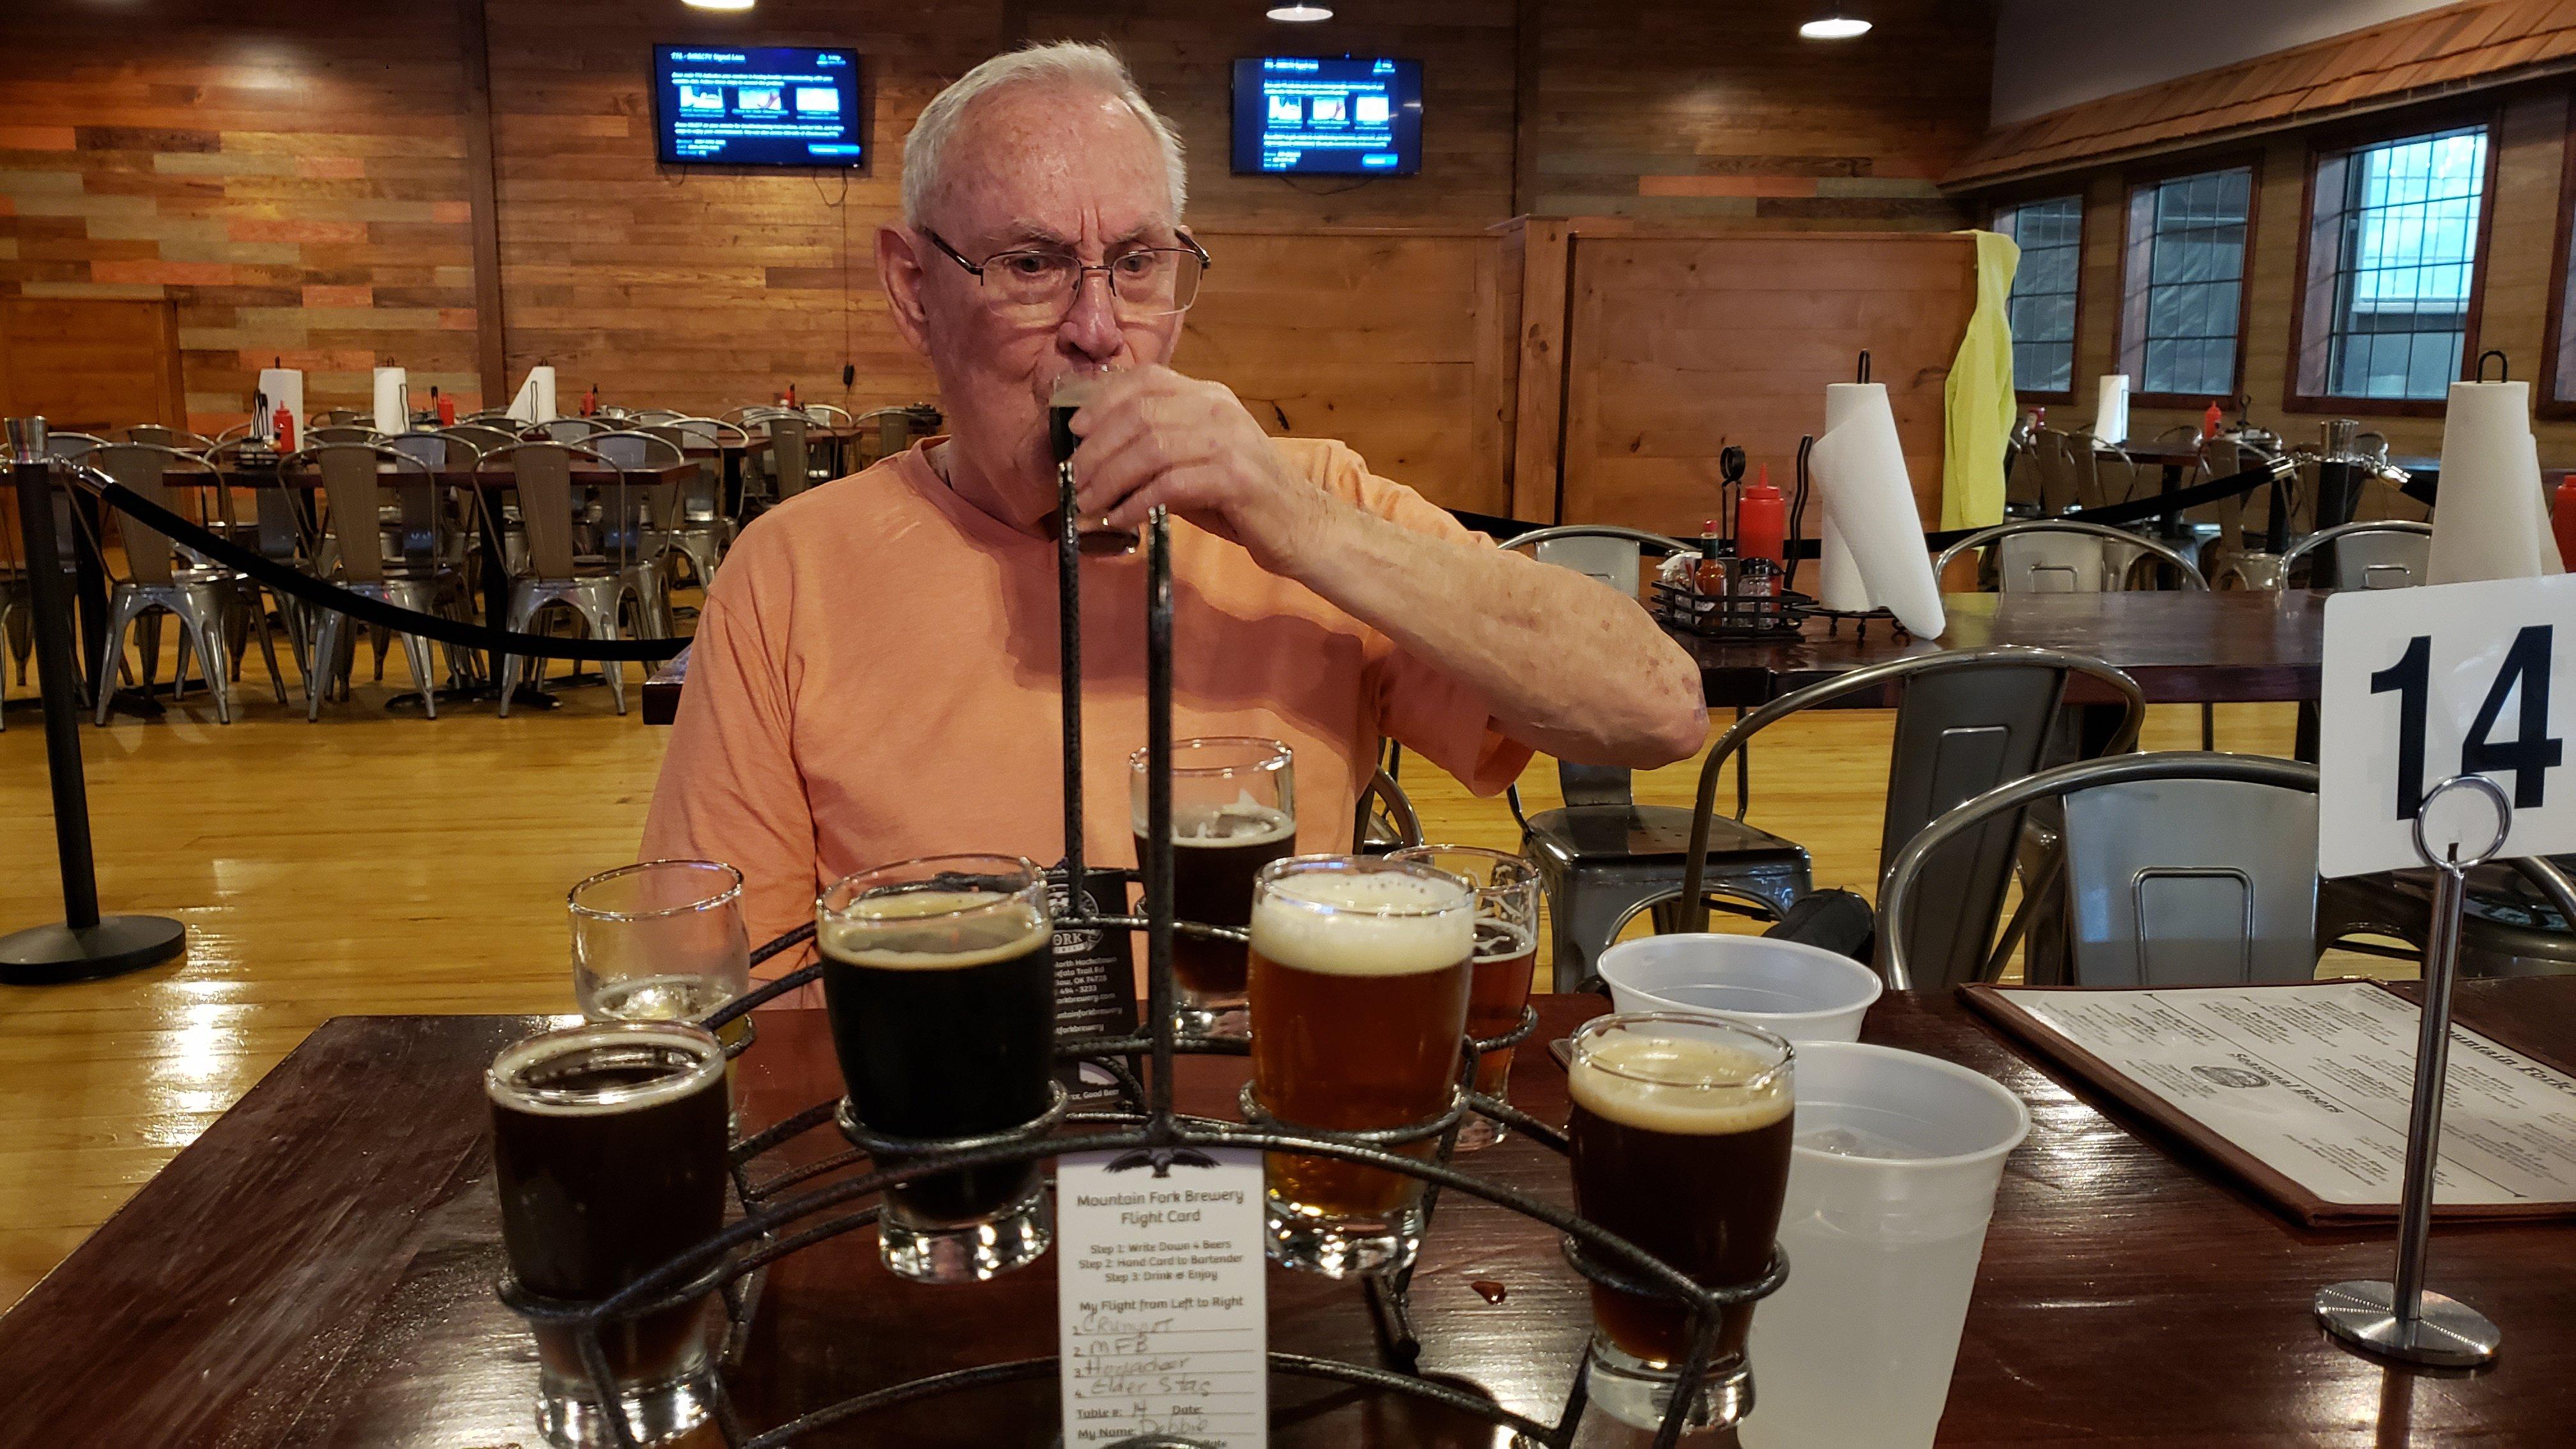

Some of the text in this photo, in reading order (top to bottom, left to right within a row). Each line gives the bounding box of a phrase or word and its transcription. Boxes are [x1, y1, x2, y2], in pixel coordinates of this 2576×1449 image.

[2371, 625, 2563, 820] 14
[1052, 932, 1083, 946] ORK
[2451, 1031, 2518, 1066] untain
[2226, 1054, 2302, 1087] Seasonal
[1077, 1190, 1245, 1207] Mountain Fork Brewery
[1121, 1209, 1201, 1228] Flight Card
[1090, 1245, 1114, 1255] Step
[1128, 1243, 1156, 1253] Write
[1159, 1241, 1190, 1252] Down
[1202, 1240, 1232, 1250] Beers
[1078, 1259, 1103, 1271] Step
[1117, 1257, 1146, 1267] Hand
[1149, 1256, 1175, 1266] Card
[1177, 1256, 1188, 1265] to
[1190, 1254, 1243, 1264] Bartender
[1105, 1272, 1128, 1283] Step
[1144, 1271, 1172, 1281] Drink
[1188, 1269, 1218, 1281] Enjoy
[1080, 1296, 1244, 1314] My Flight from Left to Right
[1077, 1407, 1109, 1418] Table
[1078, 1428, 1096, 1441] My
